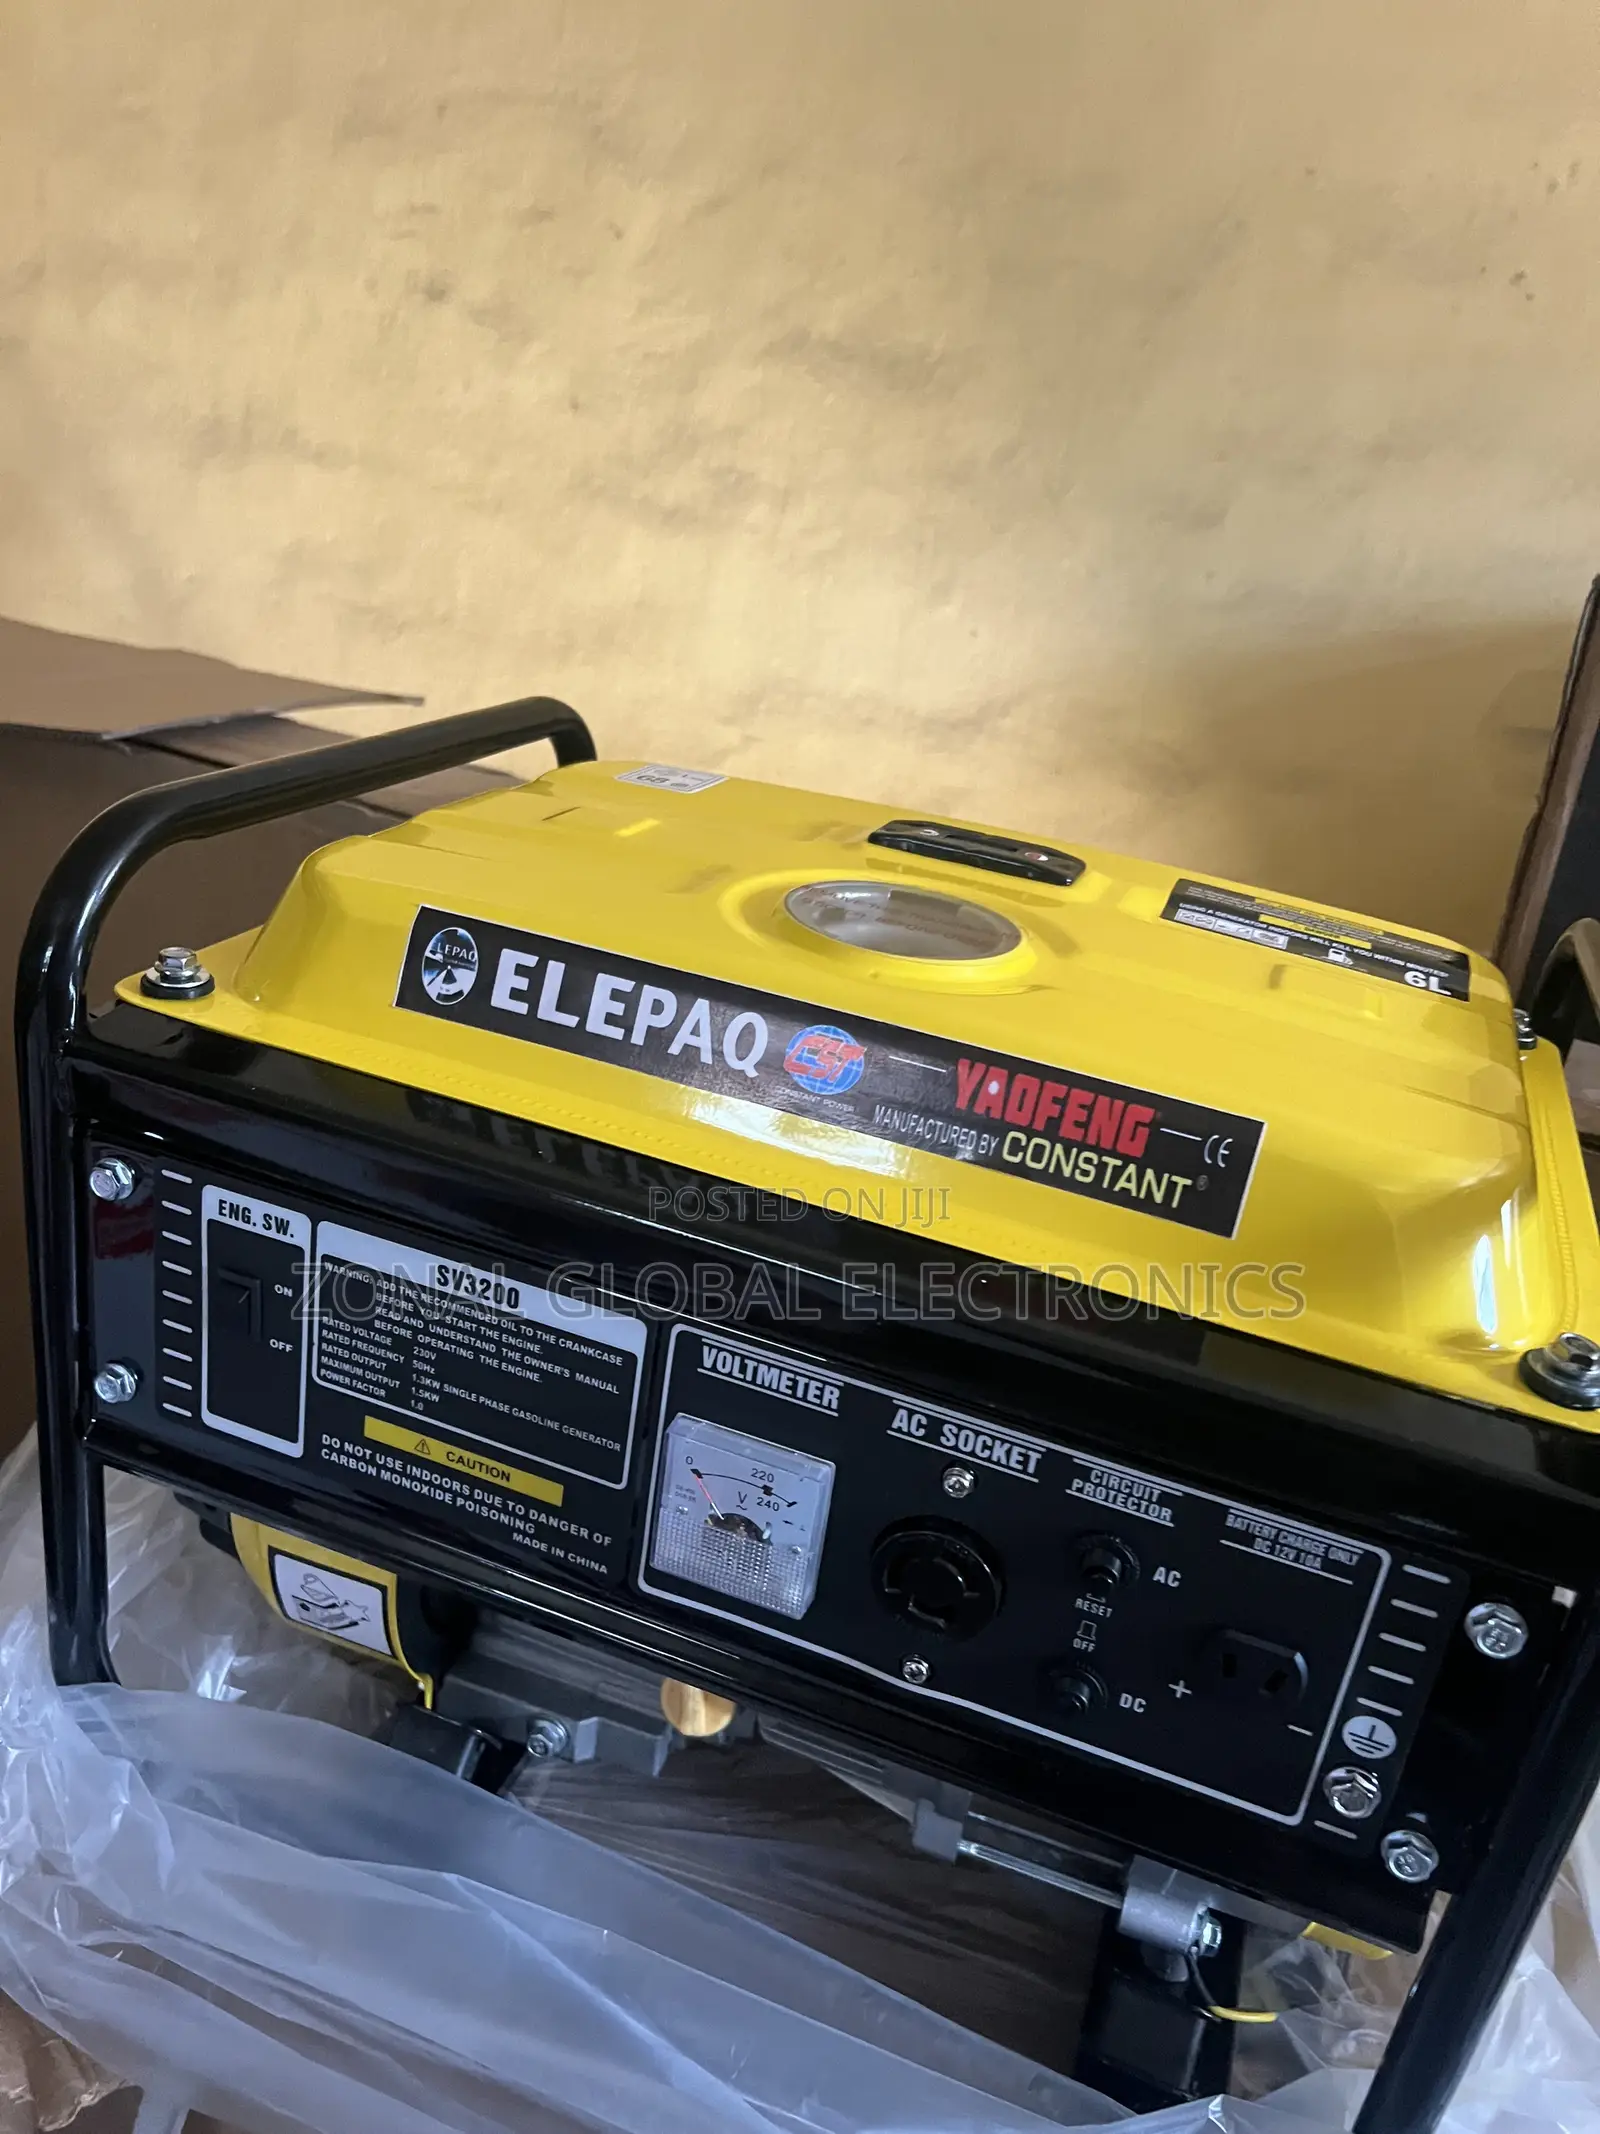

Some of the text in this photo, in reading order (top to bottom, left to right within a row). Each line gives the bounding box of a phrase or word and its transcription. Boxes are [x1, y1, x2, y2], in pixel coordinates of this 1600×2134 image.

[1353, 948, 1373, 958] YOU
[1404, 971, 1451, 996] 6L
[490, 948, 769, 1078] ELEPAQ
[956, 1058, 1155, 1158] YAOFENG
[872, 1104, 1000, 1157] MANUFACTURED BY
[1002, 1130, 1192, 1209] CONSTANT
[218, 1199, 295, 1238] ENG. SW.
[274, 1284, 293, 1298] ON
[436, 1264, 520, 1310] SV3200
[375, 1292, 414, 1312] BEFORE
[420, 1304, 440, 1320] YOU
[445, 1315, 477, 1332] START
[479, 1326, 500, 1340] THE
[377, 1279, 396, 1292] ADD
[400, 1285, 419, 1300] THE
[421, 1292, 498, 1325] RECOMMENDED
[500, 1318, 518, 1332] OIL
[520, 1324, 533, 1337] TO
[535, 1331, 556, 1344] THE
[558, 1337, 623, 1366] CRANKCASE
[269, 1338, 293, 1353] OFF
[322, 1316, 437, 1361] RATED VOLTAGE 230V
[322, 1329, 436, 1375] RATED FREQUENCY 50Hz
[374, 1319, 413, 1339] BEFORE
[417, 1334, 474, 1360] OPERATING
[479, 1354, 500, 1368] THE
[375, 1306, 620, 1395] READ AND UNDERSTAND THE OWNER'S MANUAL
[320, 1355, 440, 1403] MAXIMUM OUTPUT 1.5KW
[320, 1368, 351, 1386] POWER
[352, 1380, 387, 1398] FACTOR
[321, 1342, 622, 1452] RATED OUTPUT 1.3KW SINGLE PHASE GASOLINE GENERATOR
[702, 1345, 840, 1410] VOLTMETER
[891, 1408, 1042, 1474] AC SOCKET
[446, 1451, 511, 1483] CAUTION
[750, 1467, 775, 1483] 220
[1090, 1469, 1162, 1503] CIRCUIT
[321, 1433, 612, 1547] DO NOT USE INDOORS DUE TO DANGER OF
[321, 1448, 536, 1534] CARBON MONOXIDE POISONING
[756, 1496, 780, 1512] 240
[1071, 1478, 1173, 1522] PROTECTOR
[1225, 1513, 1279, 1541] BATTERY
[1253, 1537, 1273, 1553] DC
[1274, 1544, 1297, 1561] 12V
[512, 1532, 608, 1574] MADE IN CHINA
[1152, 1566, 1182, 1588] AC
[1075, 1598, 1113, 1618] RESET
[1072, 1637, 1096, 1652] OFF
[1119, 1692, 1147, 1713] DC
